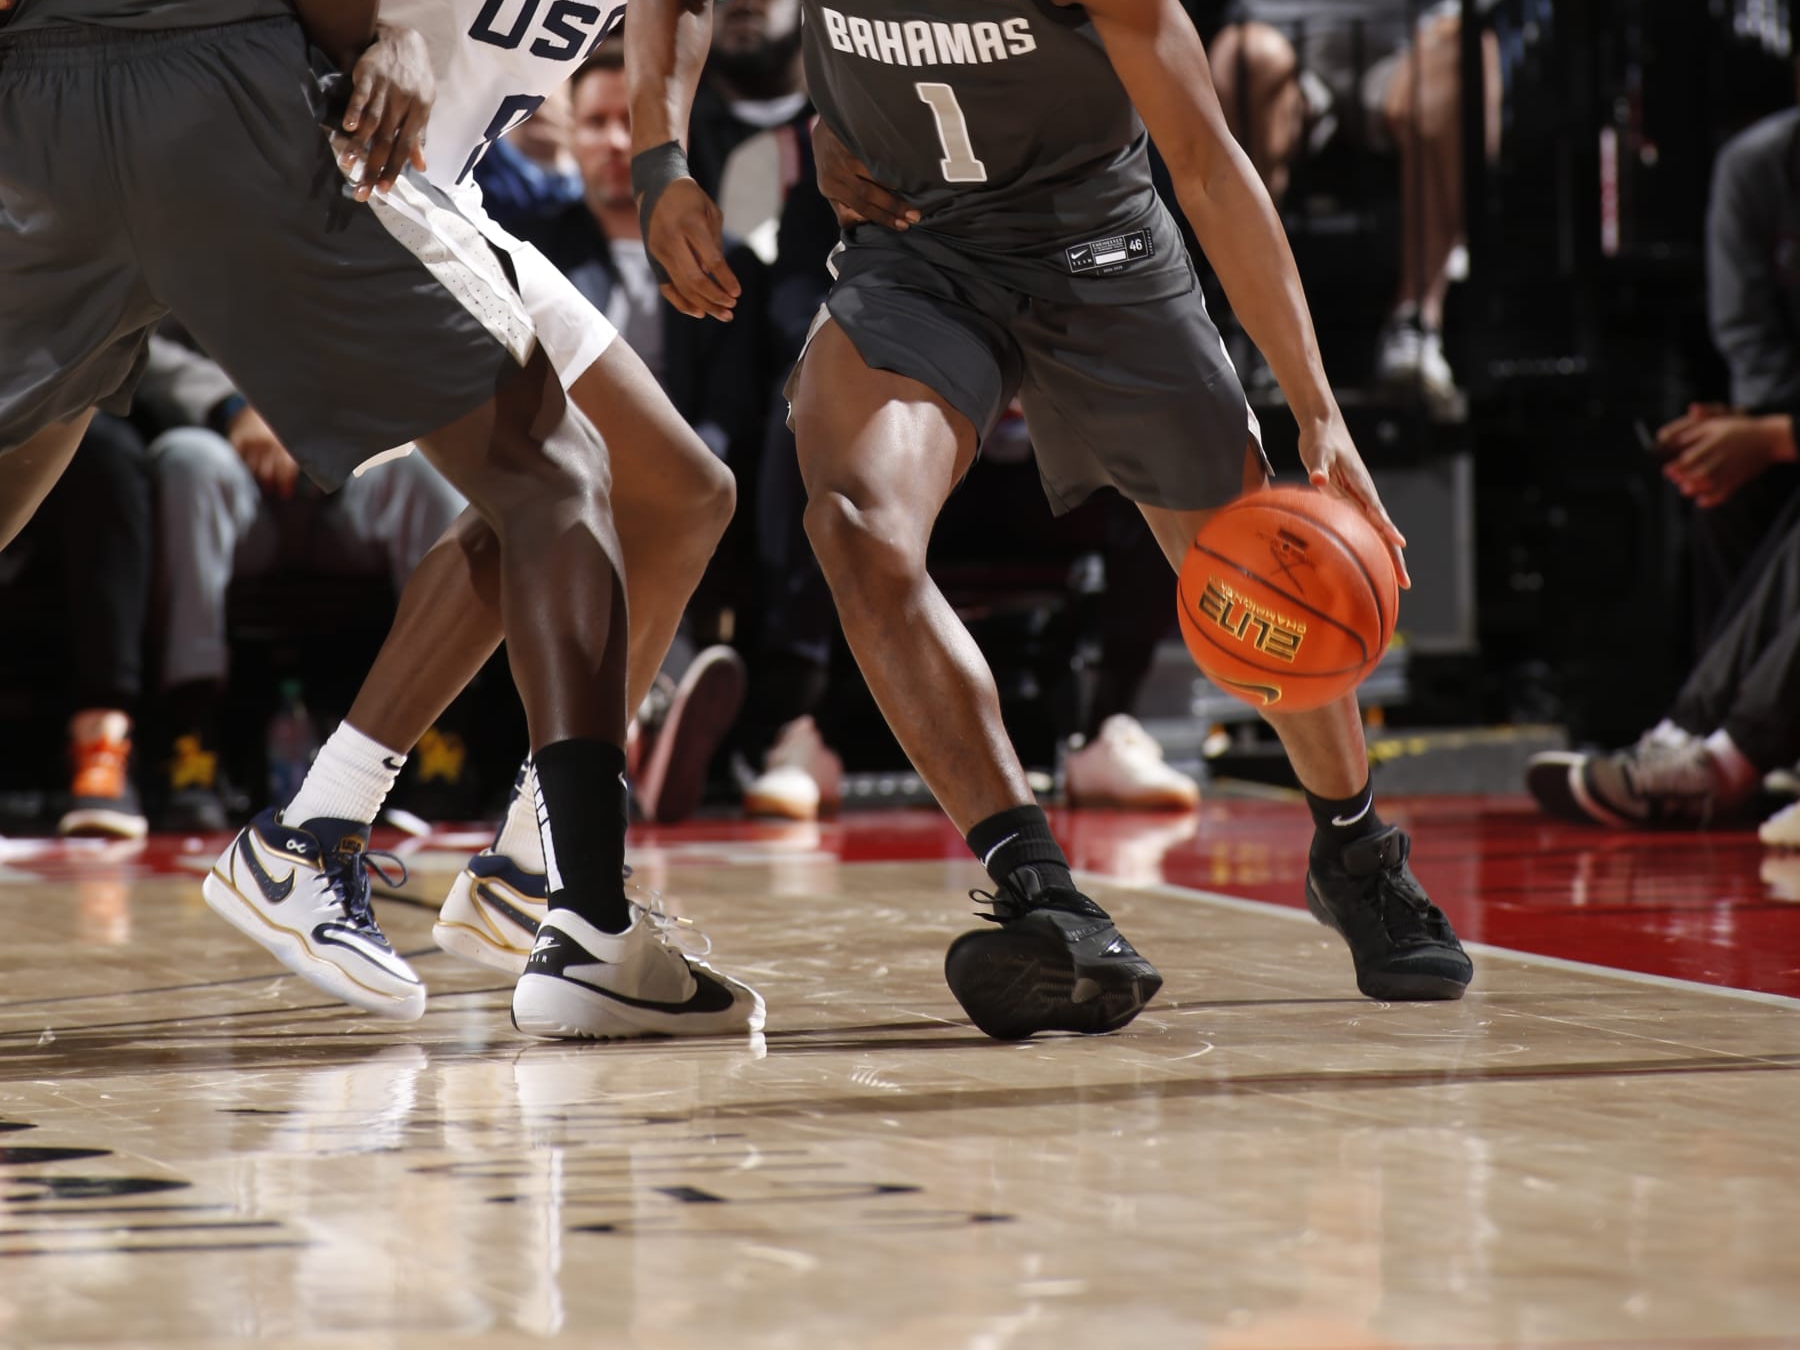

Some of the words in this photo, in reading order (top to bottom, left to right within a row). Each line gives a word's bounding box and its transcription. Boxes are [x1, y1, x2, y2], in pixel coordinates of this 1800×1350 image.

[822, 6, 1038, 67] BAHAMAS
[914, 82, 988, 183] 1
[1129, 238, 1143, 252] 46
[1198, 581, 1304, 664] ELITE
